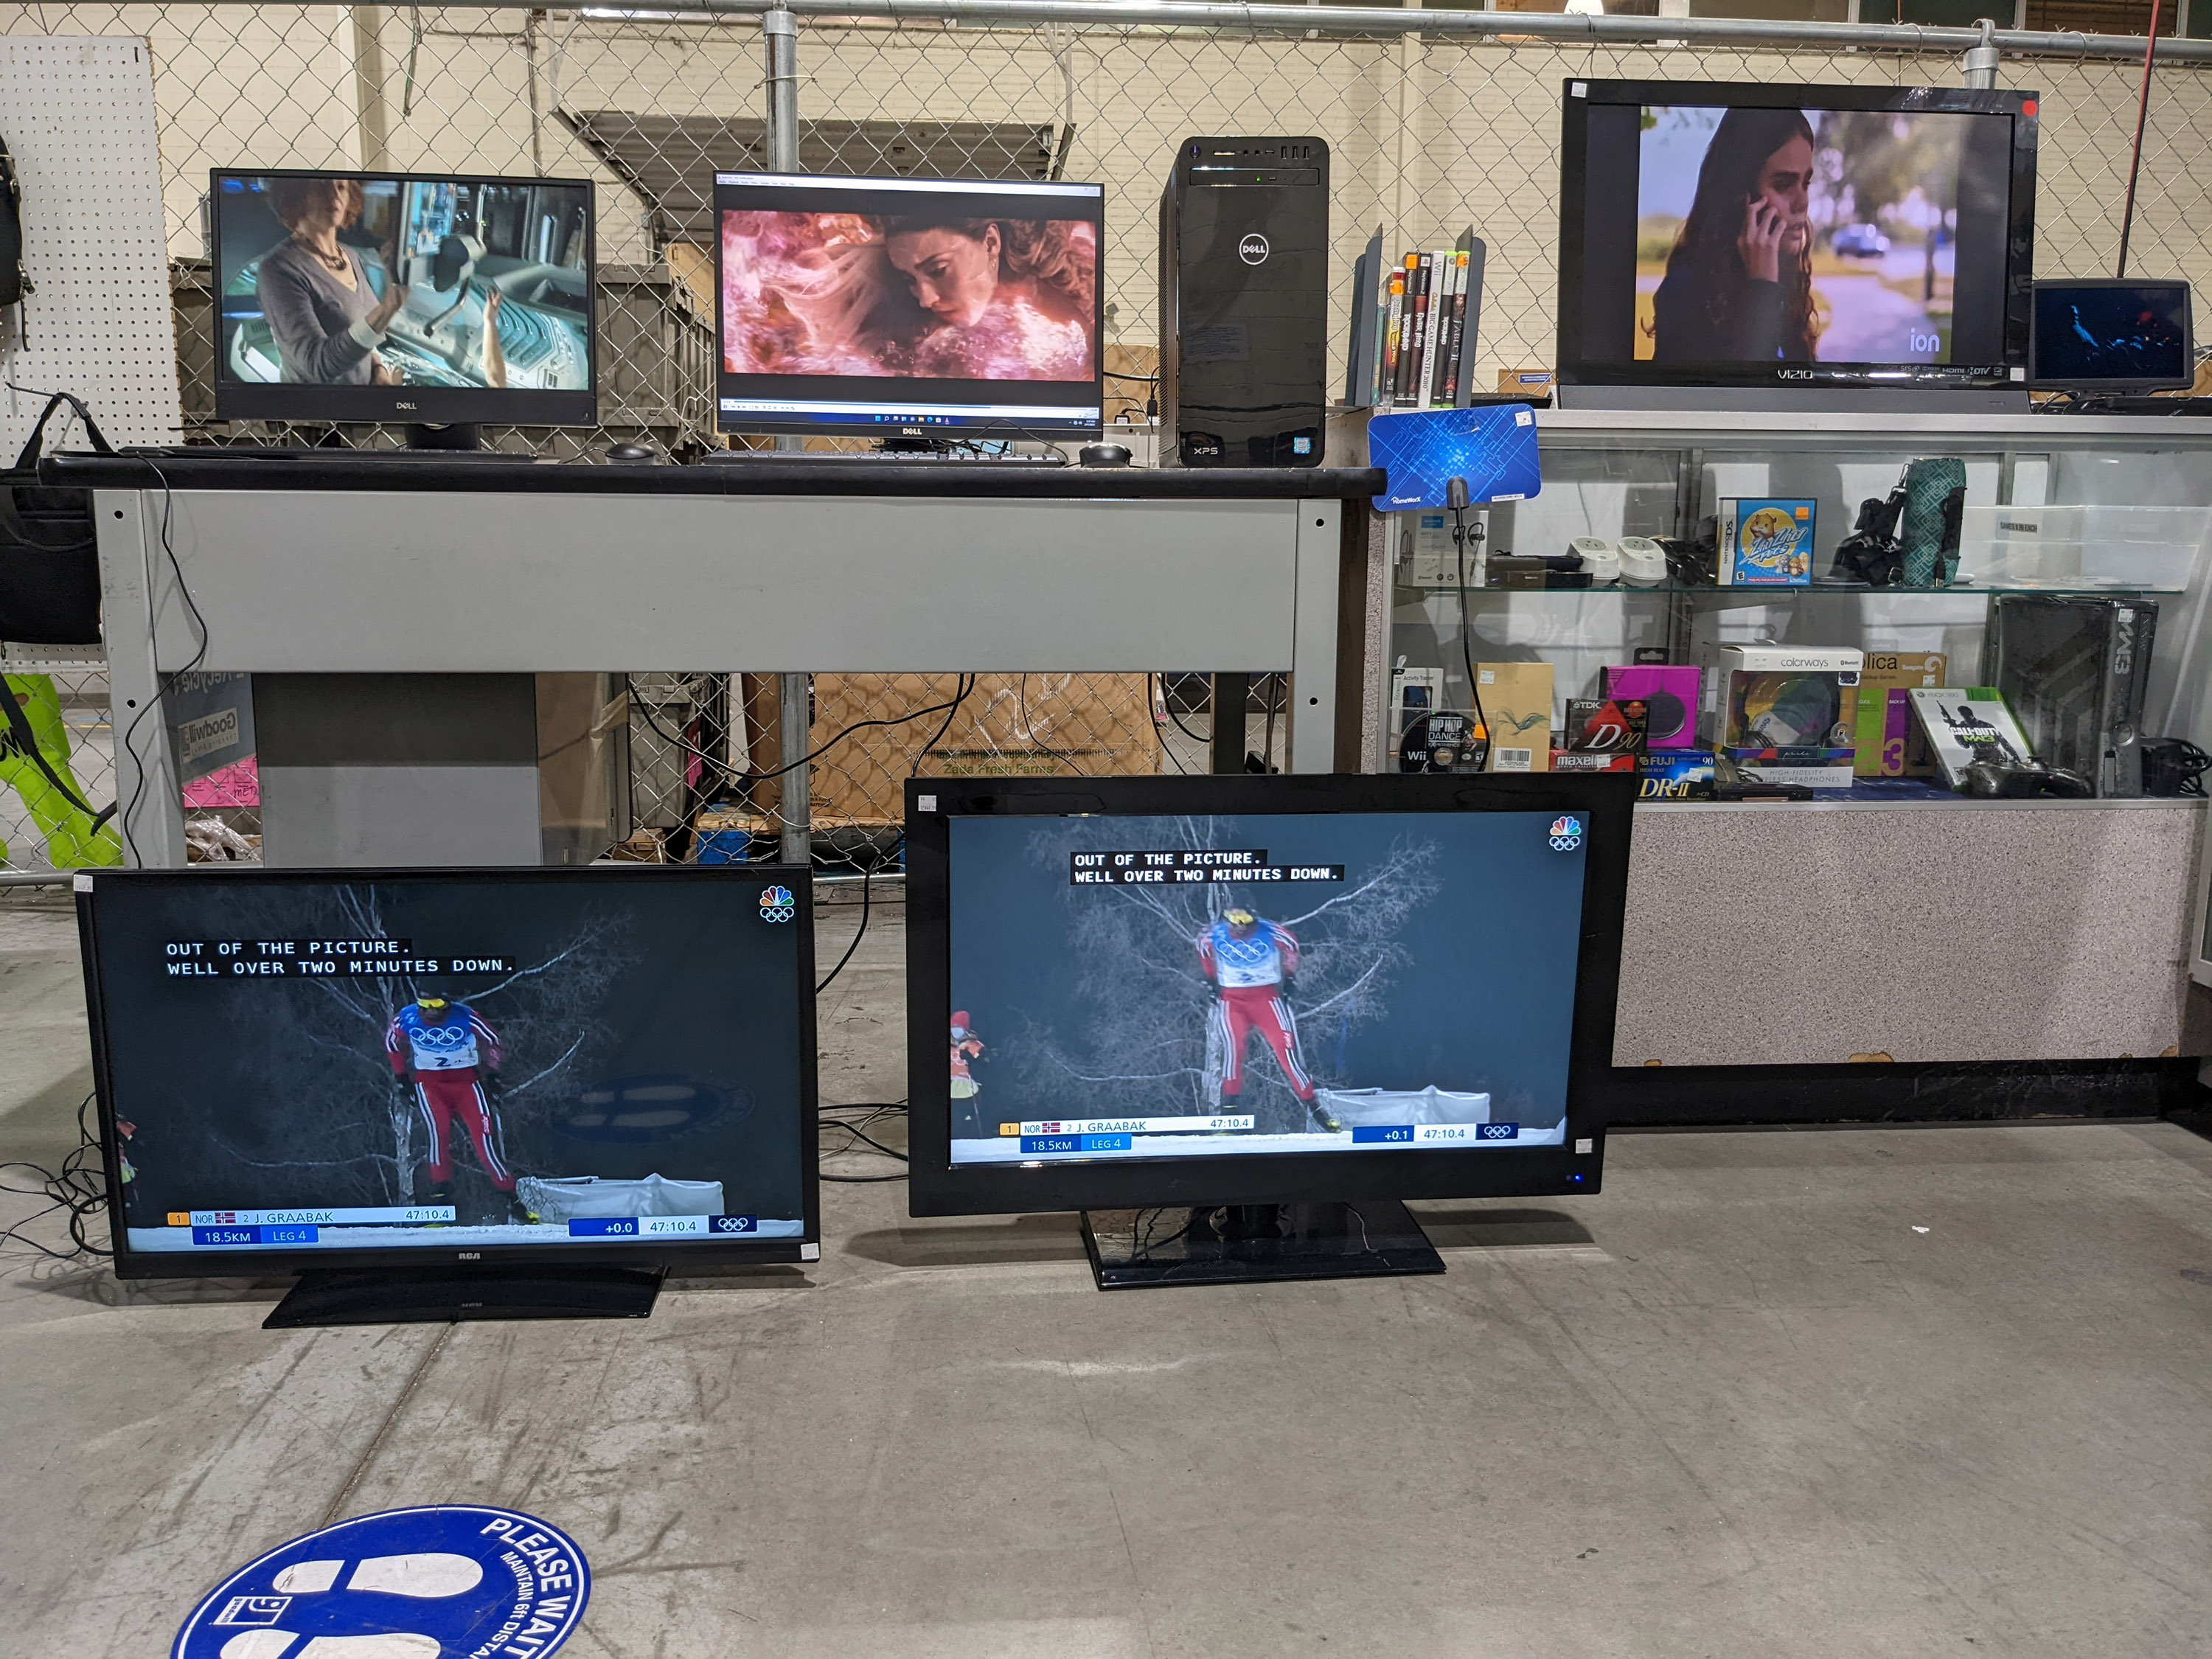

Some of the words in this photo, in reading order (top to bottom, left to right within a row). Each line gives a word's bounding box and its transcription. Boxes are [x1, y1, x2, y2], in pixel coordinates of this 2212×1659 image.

[1242, 245, 1266, 254] DELL
[1434, 261, 1442, 276] Wii
[1910, 327, 1941, 354] ion
[1425, 346, 1433, 375] HUNTER
[1778, 368, 1814, 380] VIZIO
[397, 401, 417, 411] DELL
[902, 428, 923, 436] DELL
[1193, 447, 1219, 456] XPS
[1726, 520, 1733, 536] DS
[2024, 524, 2037, 533] EACH
[1781, 658, 1829, 669] colorways
[1862, 653, 1898, 670] lica
[1902, 664, 1924, 672] Seagate
[1579, 701, 1601, 709] TDK
[1429, 718, 1444, 732] HIP
[1444, 719, 1463, 732] HOP
[1949, 726, 1972, 736] CALL
[1427, 731, 1461, 741] DANCE
[1407, 751, 1427, 761] Wii
[1650, 757, 1676, 765] FUJI
[1702, 757, 1714, 765] 90
[1882, 737, 1905, 777] 3
[943, 764, 974, 774] Zada
[978, 764, 1012, 774] Fresh
[1016, 764, 1054, 774] Farms
[1638, 778, 1691, 797] DR-II
[1074, 854, 1105, 866] OUT
[1114, 854, 1135, 866] OF
[1144, 854, 1174, 865] THE
[1183, 852, 1262, 866] PICTURE.
[1074, 871, 1114, 883] WELL
[1124, 870, 1164, 882] OVER
[1174, 869, 1204, 881] TWO
[1212, 869, 1281, 880] MINUTES
[1290, 867, 1338, 880] DOWN.
[166, 942, 204, 956] OUT
[219, 942, 243, 955] OF
[257, 942, 296, 955] THE
[309, 941, 411, 954] PICTURE.
[167, 962, 220, 975] WELL
[233, 961, 285, 975] OVER
[298, 961, 336, 973] TWO
[349, 960, 439, 973] MINUTES
[452, 959, 514, 972] DOWN.
[434, 1057, 452, 1068] 2
[1007, 1124, 1012, 1133] 1
[1023, 1124, 1040, 1134] NOR
[1066, 1124, 1072, 1133] 2
[1077, 1122, 1085, 1133] J.
[1088, 1121, 1147, 1133] GRAABAK
[1210, 1119, 1249, 1128] 47:10.4
[1384, 1130, 1408, 1140] +0.1
[1423, 1128, 1465, 1139] 47:10.4
[1032, 1141, 1072, 1152] 18.5KM
[1091, 1139, 1111, 1150] LEG
[1114, 1138, 1121, 1148] 4
[175, 1215, 181, 1224] 1
[195, 1214, 214, 1224] NOR
[243, 1214, 249, 1223] 2
[254, 1213, 264, 1224] J.
[266, 1211, 333, 1223] GRAABAK
[405, 1209, 450, 1220] 47:10.4
[605, 1222, 633, 1234] +0.0
[650, 1220, 697, 1232] 47:10.4
[204, 1231, 251, 1243] 18.5KM
[273, 1231, 296, 1242] LEG
[298, 1230, 307, 1241] 4
[459, 1252, 481, 1260] RCA
[479, 1517, 572, 1593] PLEASE
[499, 1551, 534, 1601] MAINTAIN
[509, 1603, 531, 1619] 6ft
[504, 1595, 571, 1659] WAIT
